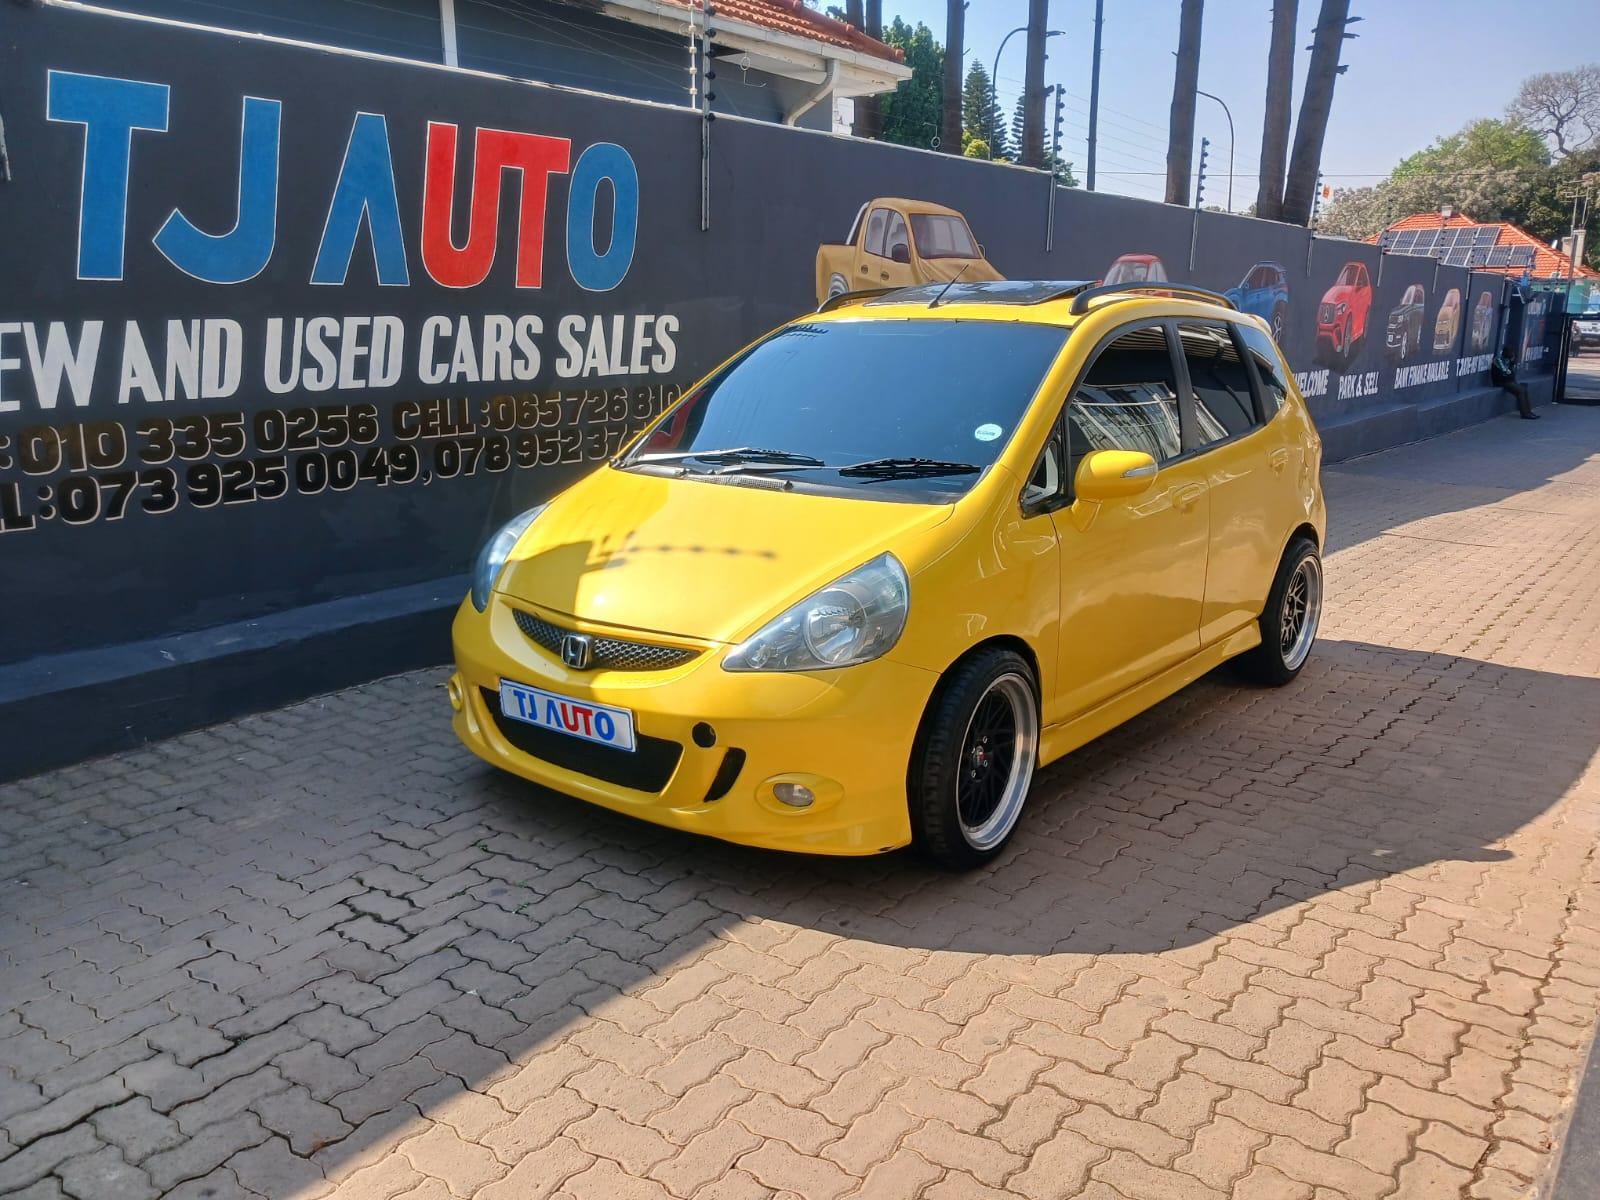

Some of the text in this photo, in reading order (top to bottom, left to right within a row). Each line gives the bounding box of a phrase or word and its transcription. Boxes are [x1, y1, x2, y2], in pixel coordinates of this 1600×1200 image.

[46, 69, 639, 291] TJ AUTO
[119, 318, 243, 404] AND
[264, 315, 404, 394] USED
[418, 314, 543, 384] CARS
[556, 313, 680, 377] SALES
[1337, 371, 1379, 400] PARK & SELL
[136, 411, 246, 465] 335
[252, 402, 380, 453] 0256
[565, 386, 629, 427] 726
[632, 381, 696, 420] 810
[186, 454, 289, 509] 925
[515, 427, 583, 469] 952
[585, 421, 650, 461] 37
[513, 690, 616, 741] TJ AUTO
